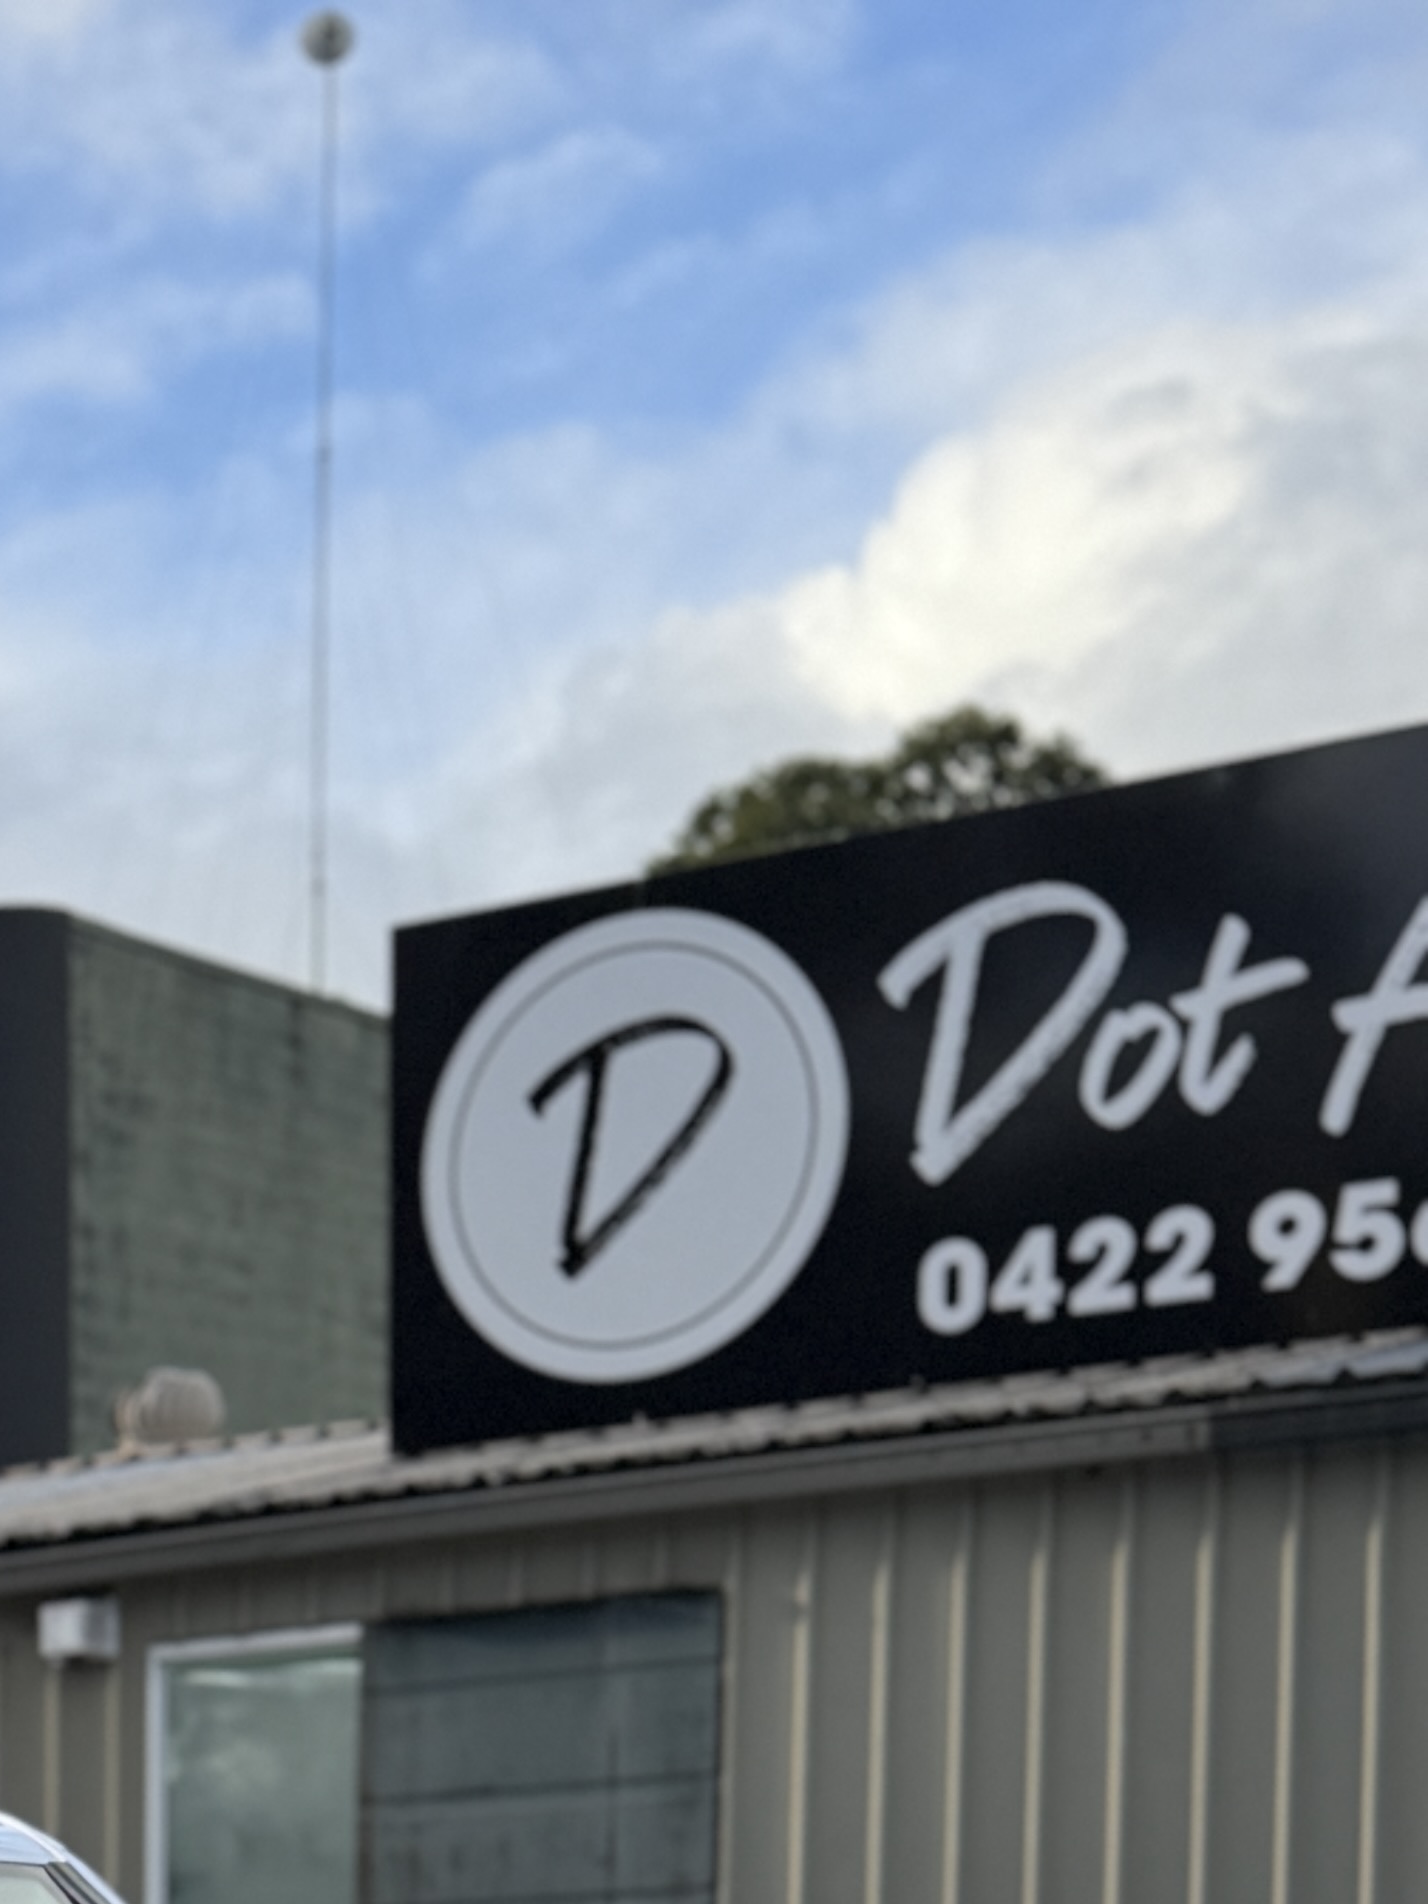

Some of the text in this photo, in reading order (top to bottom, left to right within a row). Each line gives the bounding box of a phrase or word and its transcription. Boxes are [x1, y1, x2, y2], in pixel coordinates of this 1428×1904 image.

[528, 1016, 735, 1281] D
[877, 881, 1309, 1186] Dot
[917, 1176, 1428, 1336] 0422 95
